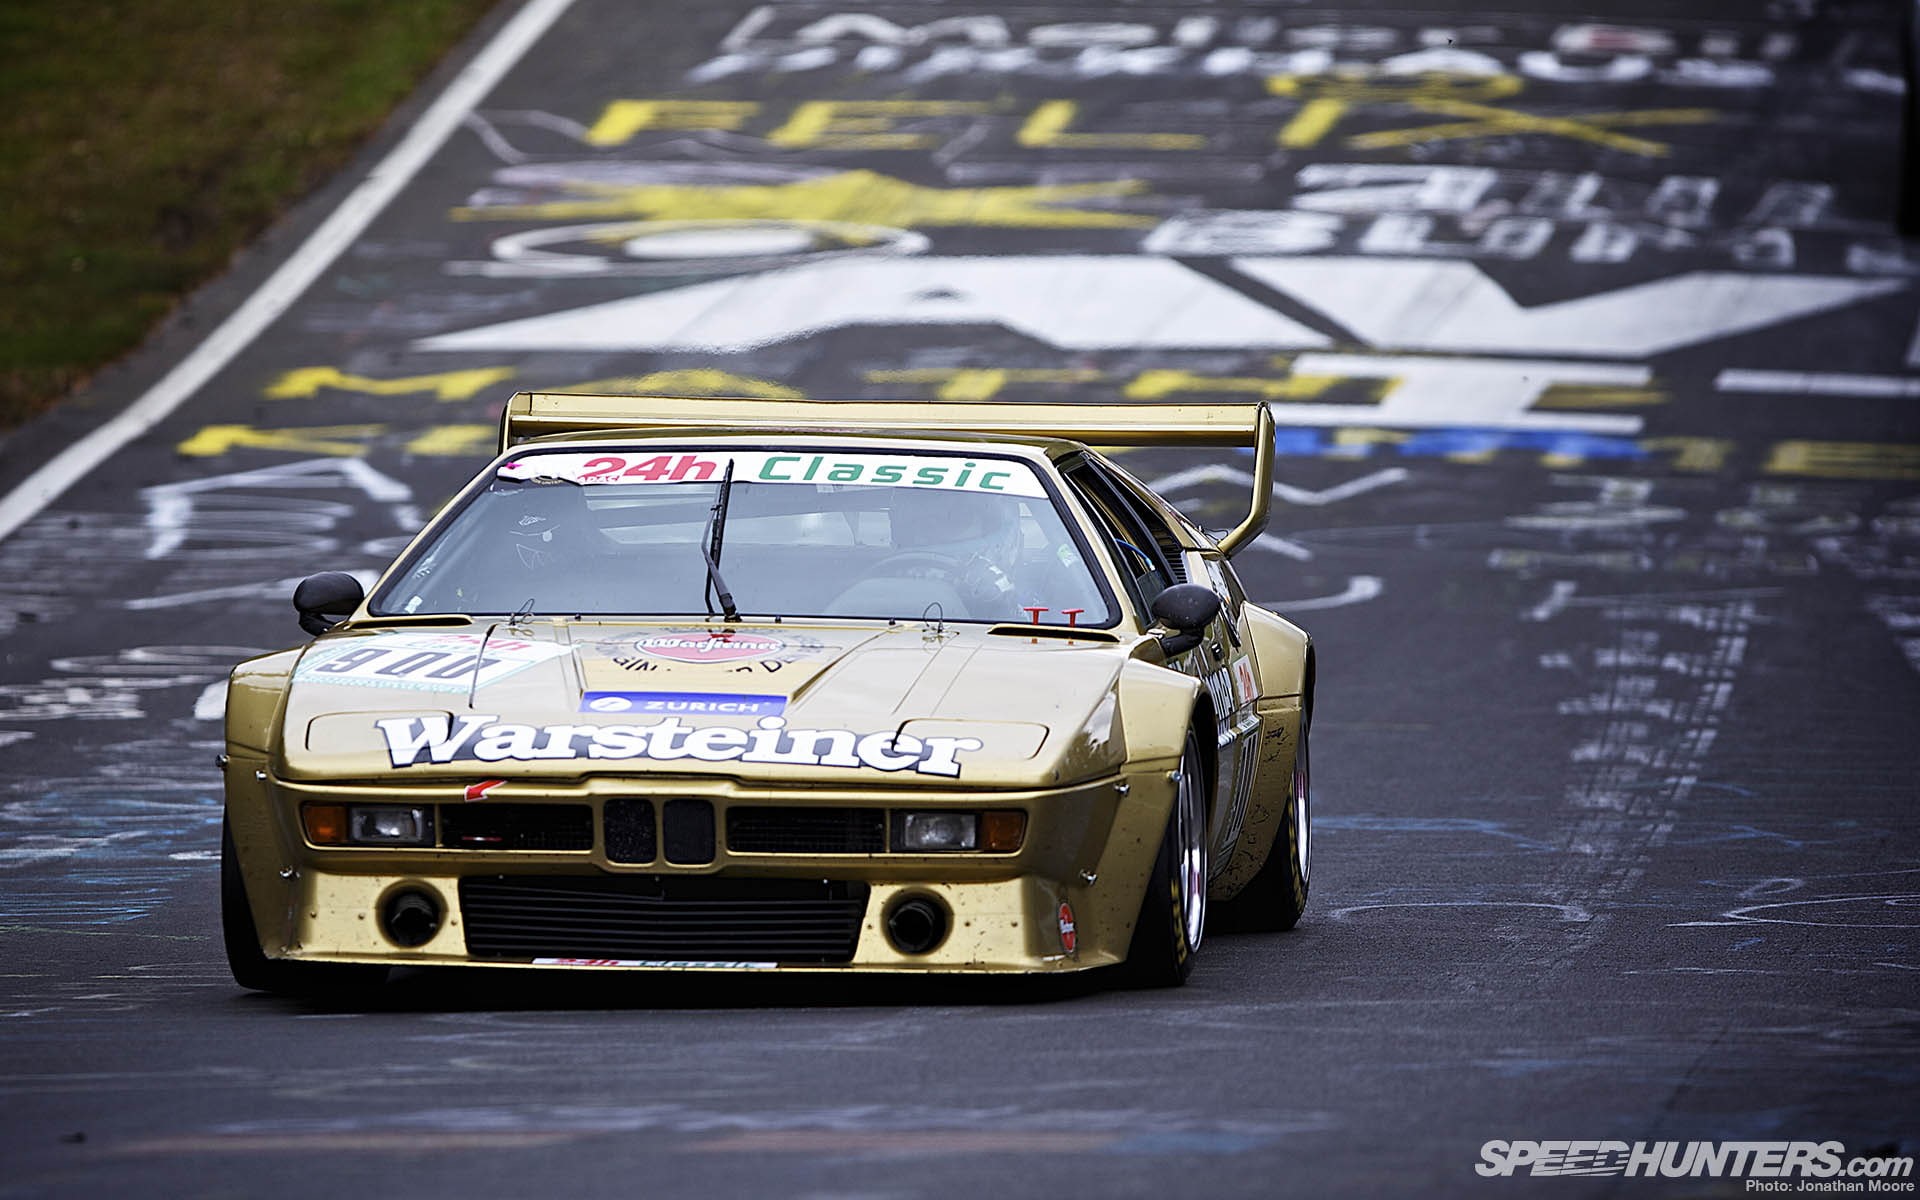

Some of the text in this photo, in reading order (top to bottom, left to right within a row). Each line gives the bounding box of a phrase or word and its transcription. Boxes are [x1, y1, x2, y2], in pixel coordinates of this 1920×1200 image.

[588, 90, 1717, 158] FELIX
[415, 254, 1920, 358] AV
[577, 455, 1012, 491] 24h Classic
[315, 648, 502, 679] 900
[643, 701, 760, 714] ZURICH
[374, 713, 984, 778] Warsteiner
